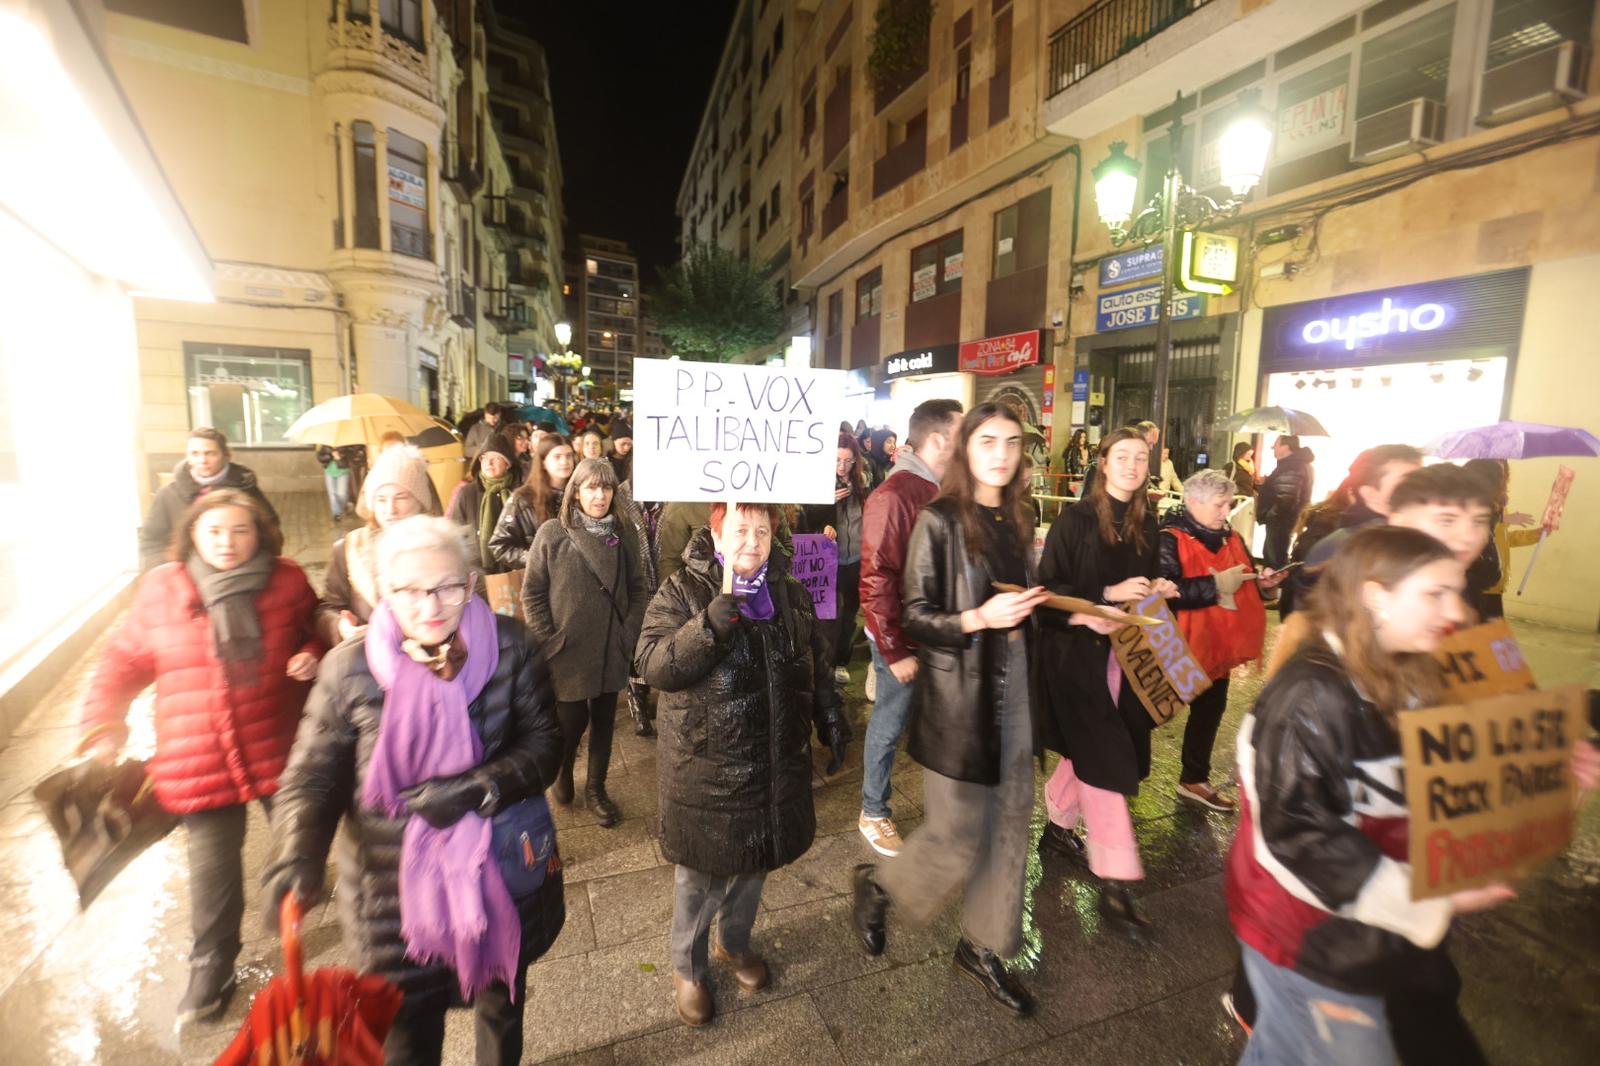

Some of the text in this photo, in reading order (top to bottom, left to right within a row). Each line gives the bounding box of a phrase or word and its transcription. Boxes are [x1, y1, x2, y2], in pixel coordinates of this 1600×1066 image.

[1106, 300, 1188, 328] JOSE LIS
[1302, 298, 1445, 350] oysho
[699, 460, 778, 493] SON
[1417, 721, 1476, 766] NO
